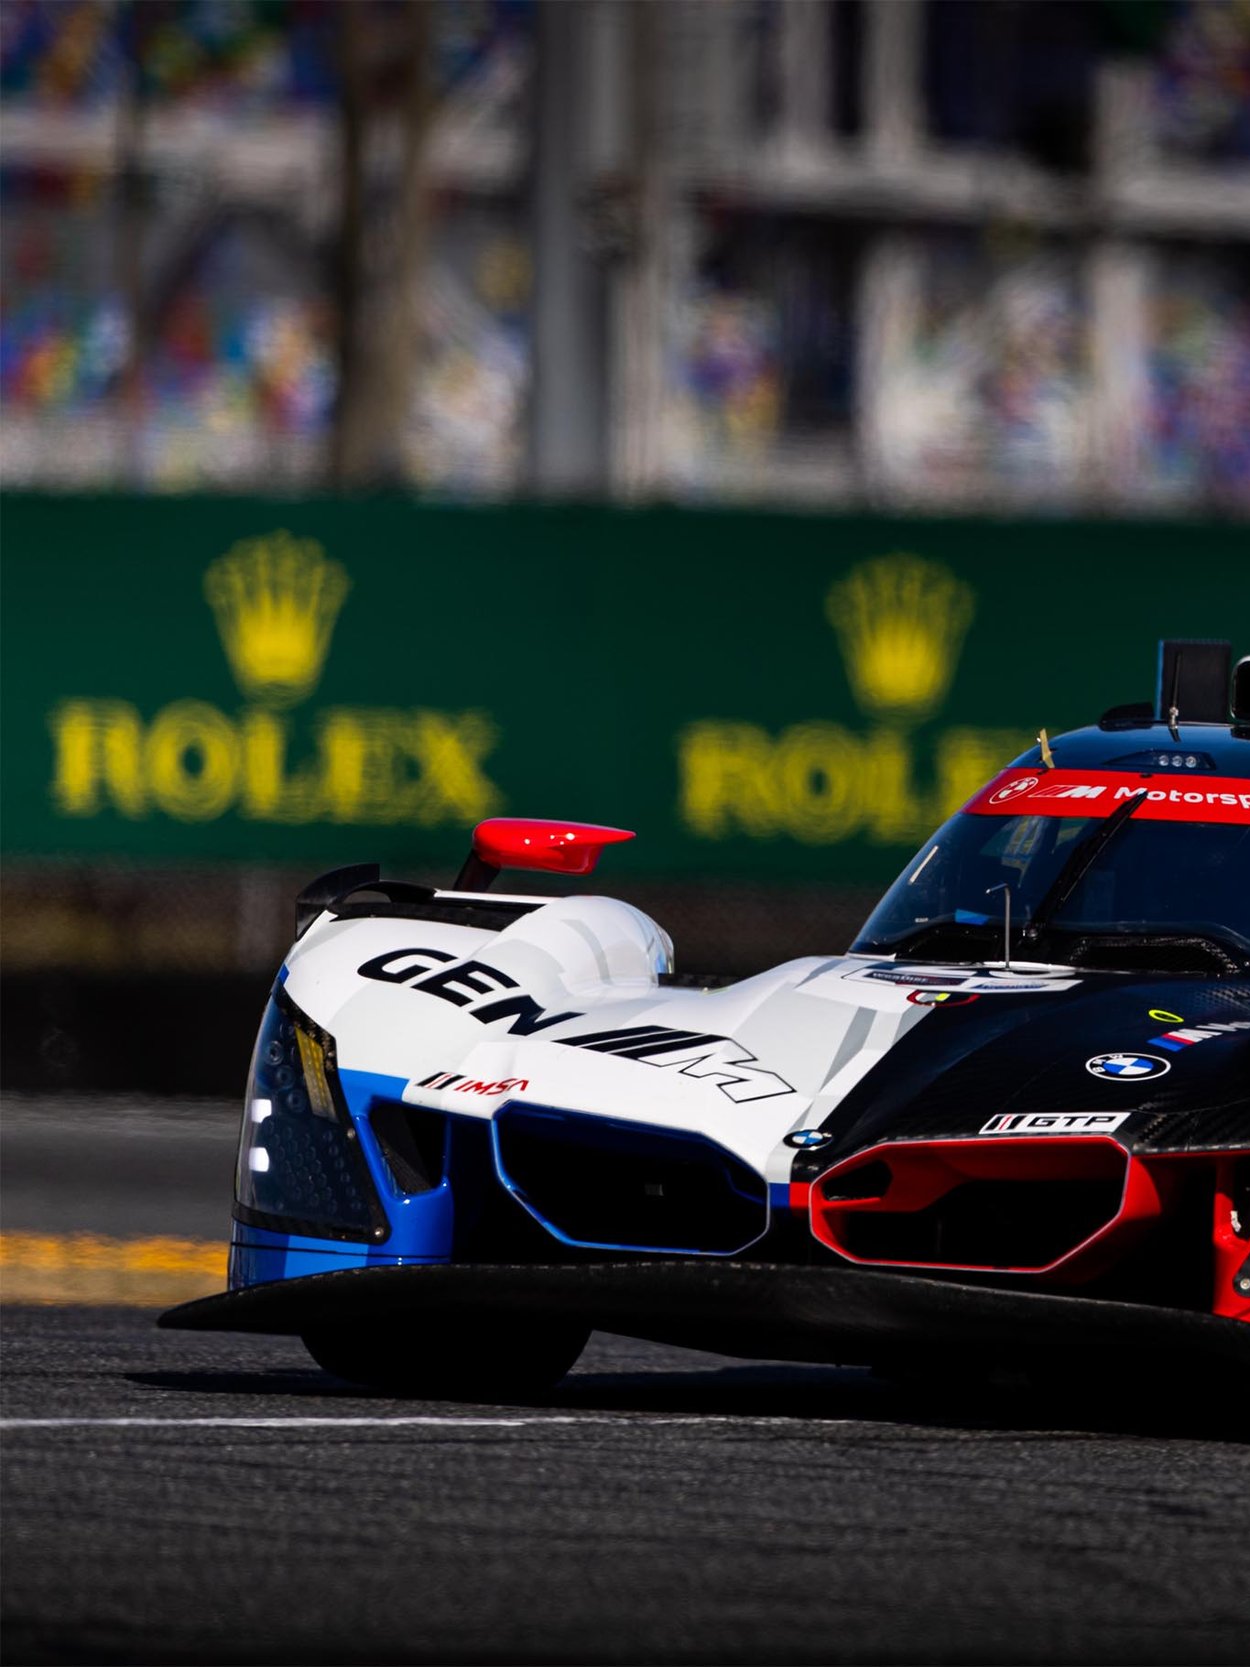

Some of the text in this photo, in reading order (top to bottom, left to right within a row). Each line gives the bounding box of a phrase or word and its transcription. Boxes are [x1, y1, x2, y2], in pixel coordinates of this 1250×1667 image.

[50, 697, 505, 827] ROLEX
[677, 719, 1038, 845] ROLE
[357, 948, 588, 1036] GEN
[1027, 1115, 1118, 1128] GTP
